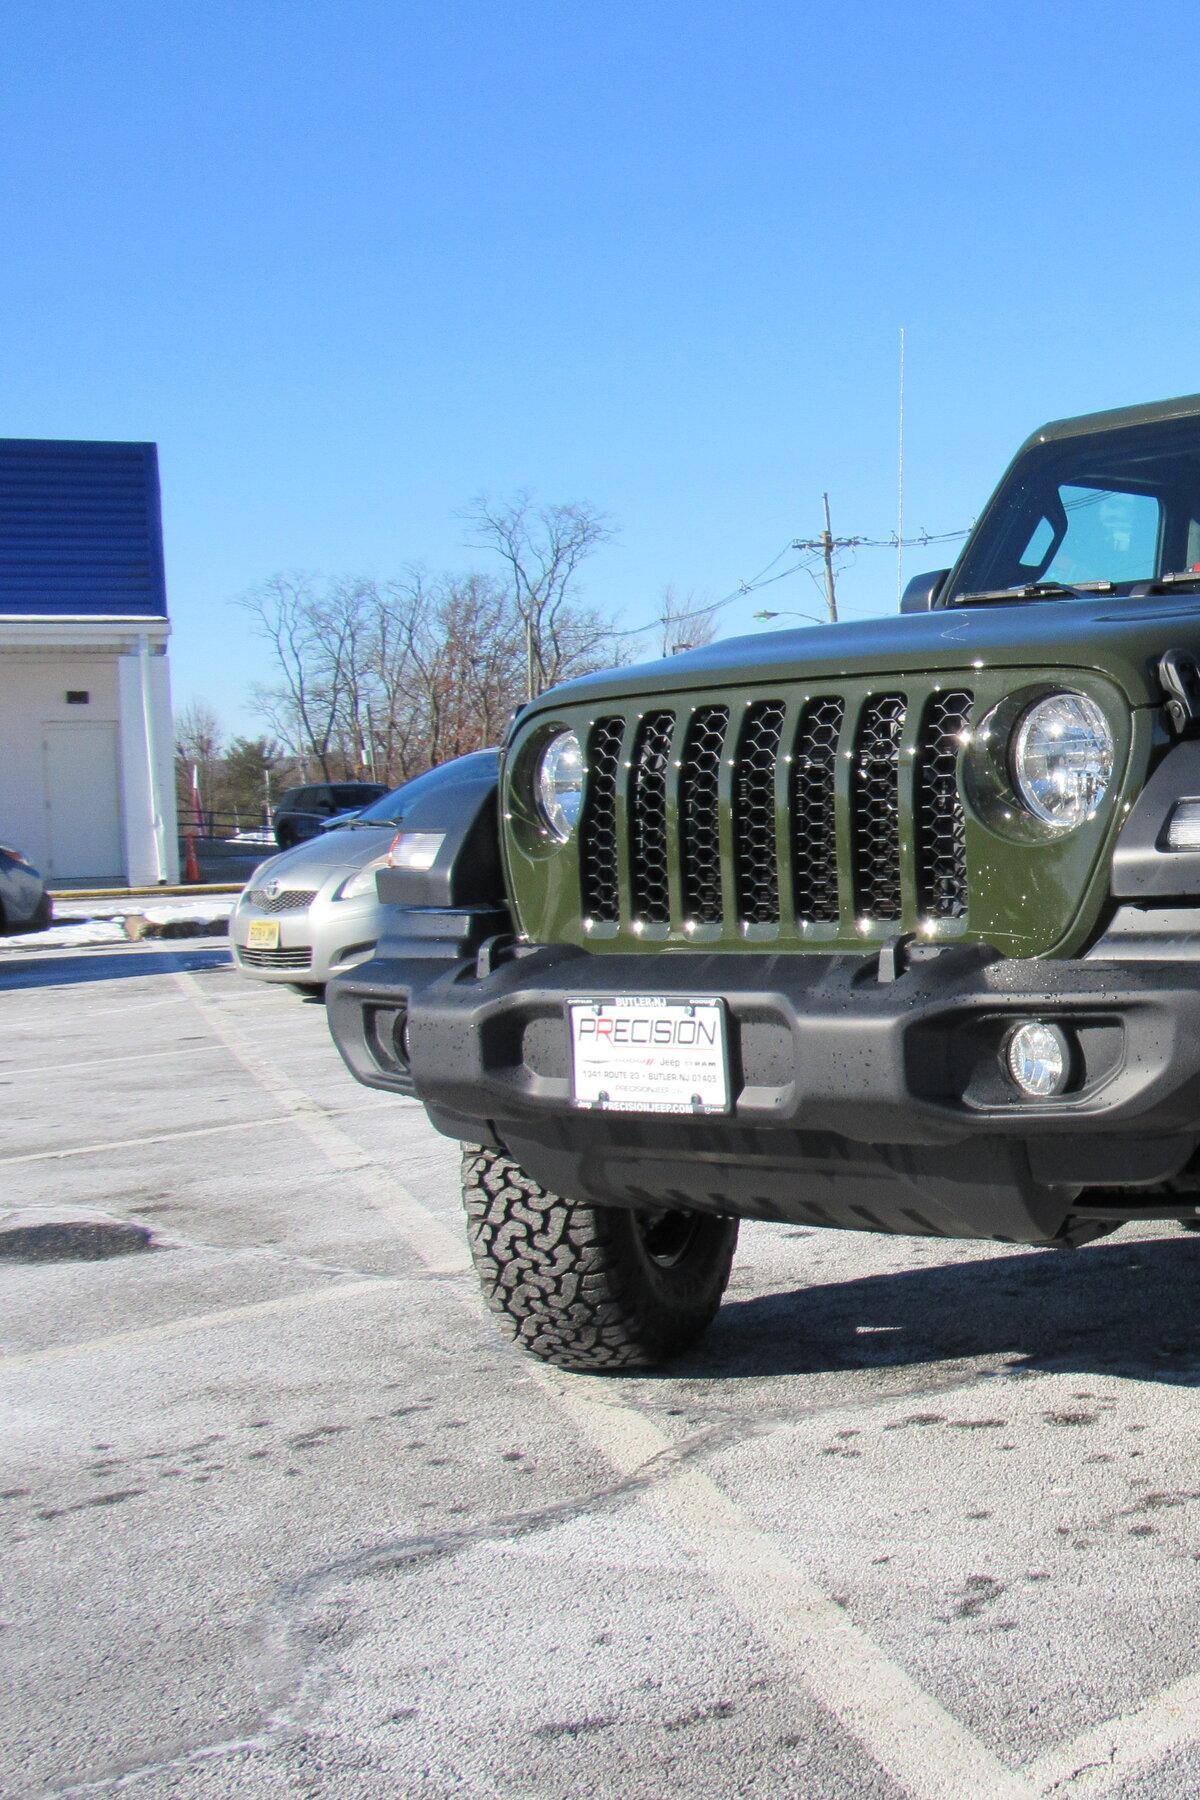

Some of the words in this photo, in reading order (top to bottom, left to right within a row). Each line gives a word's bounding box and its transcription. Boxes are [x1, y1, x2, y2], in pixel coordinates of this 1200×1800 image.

[579, 1018, 717, 1045] PRECISION
[604, 1071, 628, 1079] ROUTE
[630, 1072, 640, 1080] 23
[602, 1101, 694, 1114] PRECISIONJEEP.COM
